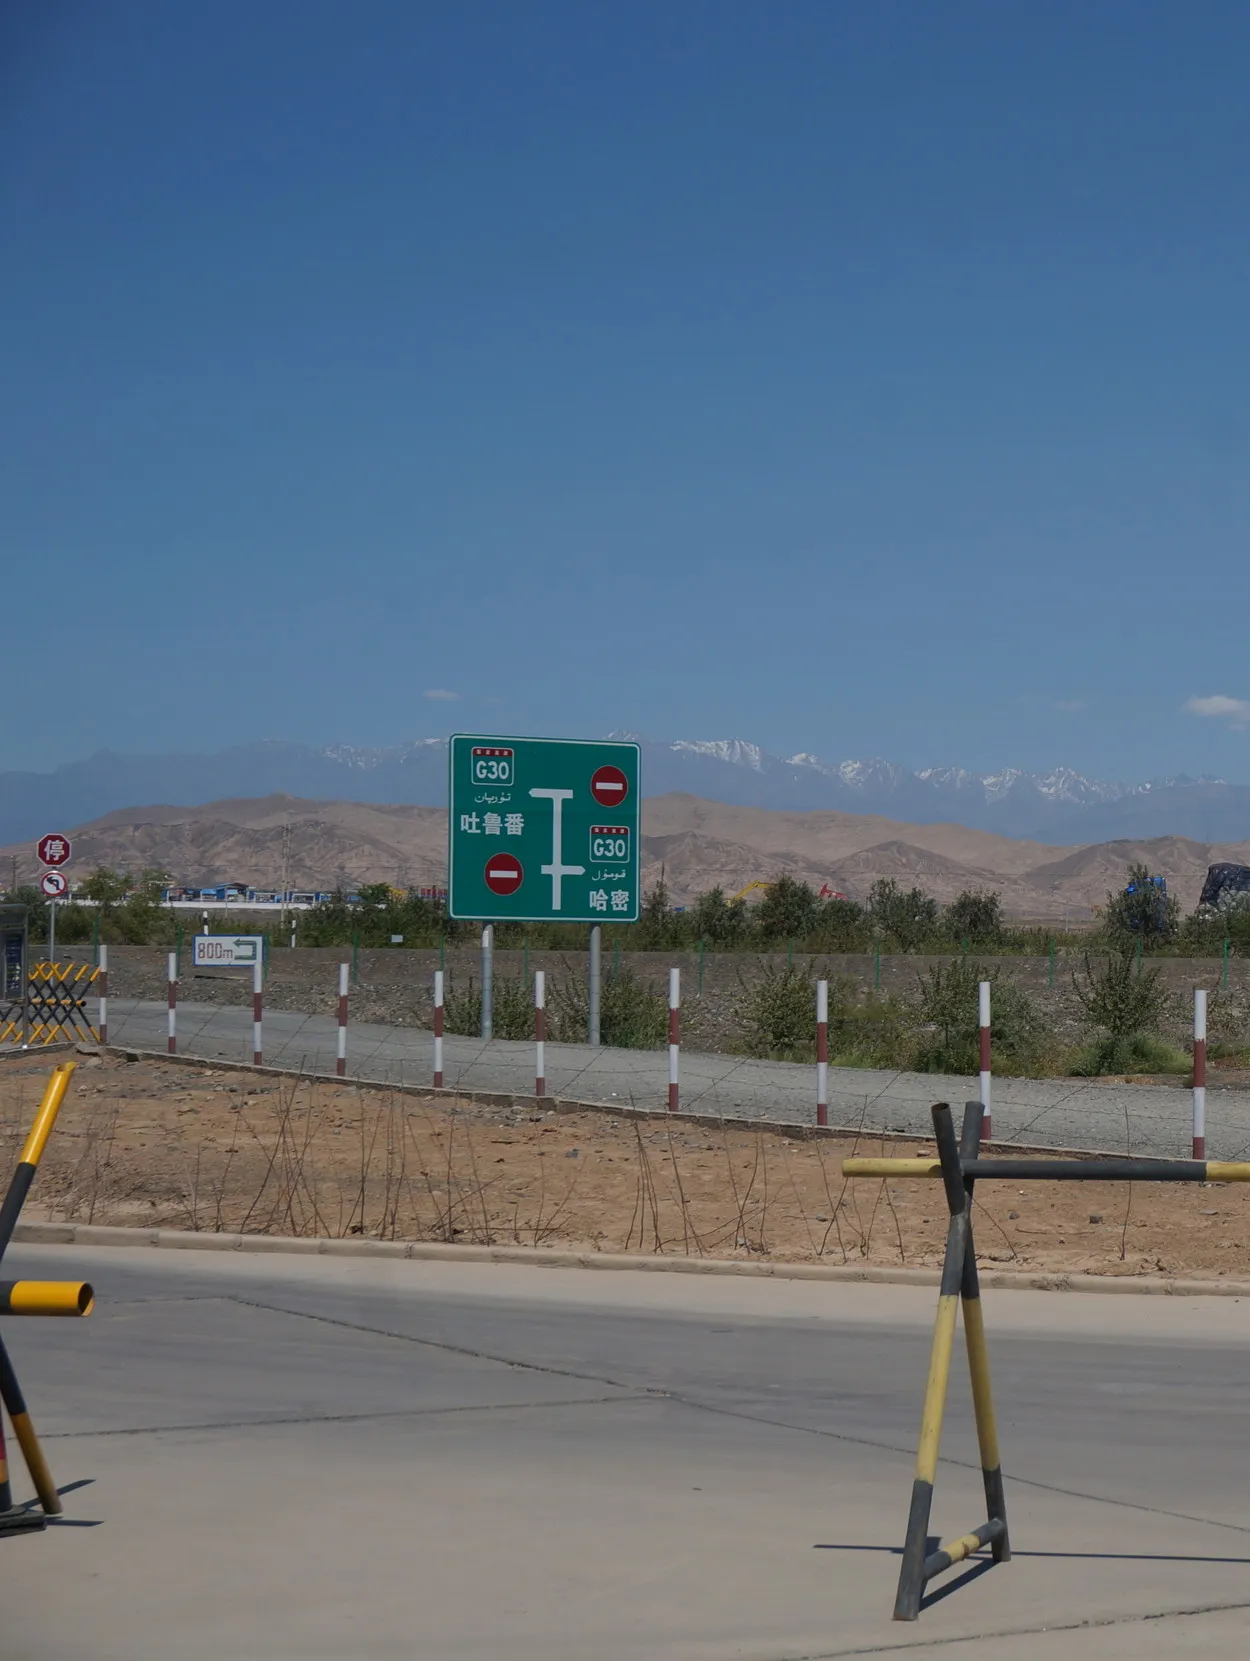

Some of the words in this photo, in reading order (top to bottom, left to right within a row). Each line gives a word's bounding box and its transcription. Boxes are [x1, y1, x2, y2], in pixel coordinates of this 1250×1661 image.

[476, 760, 510, 780] G30
[460, 811, 525, 836] 吐鲁番
[43, 839, 65, 861] 停
[593, 838, 626, 857] G30
[589, 888, 630, 912] 哈密
[197, 942, 234, 959] 800m
